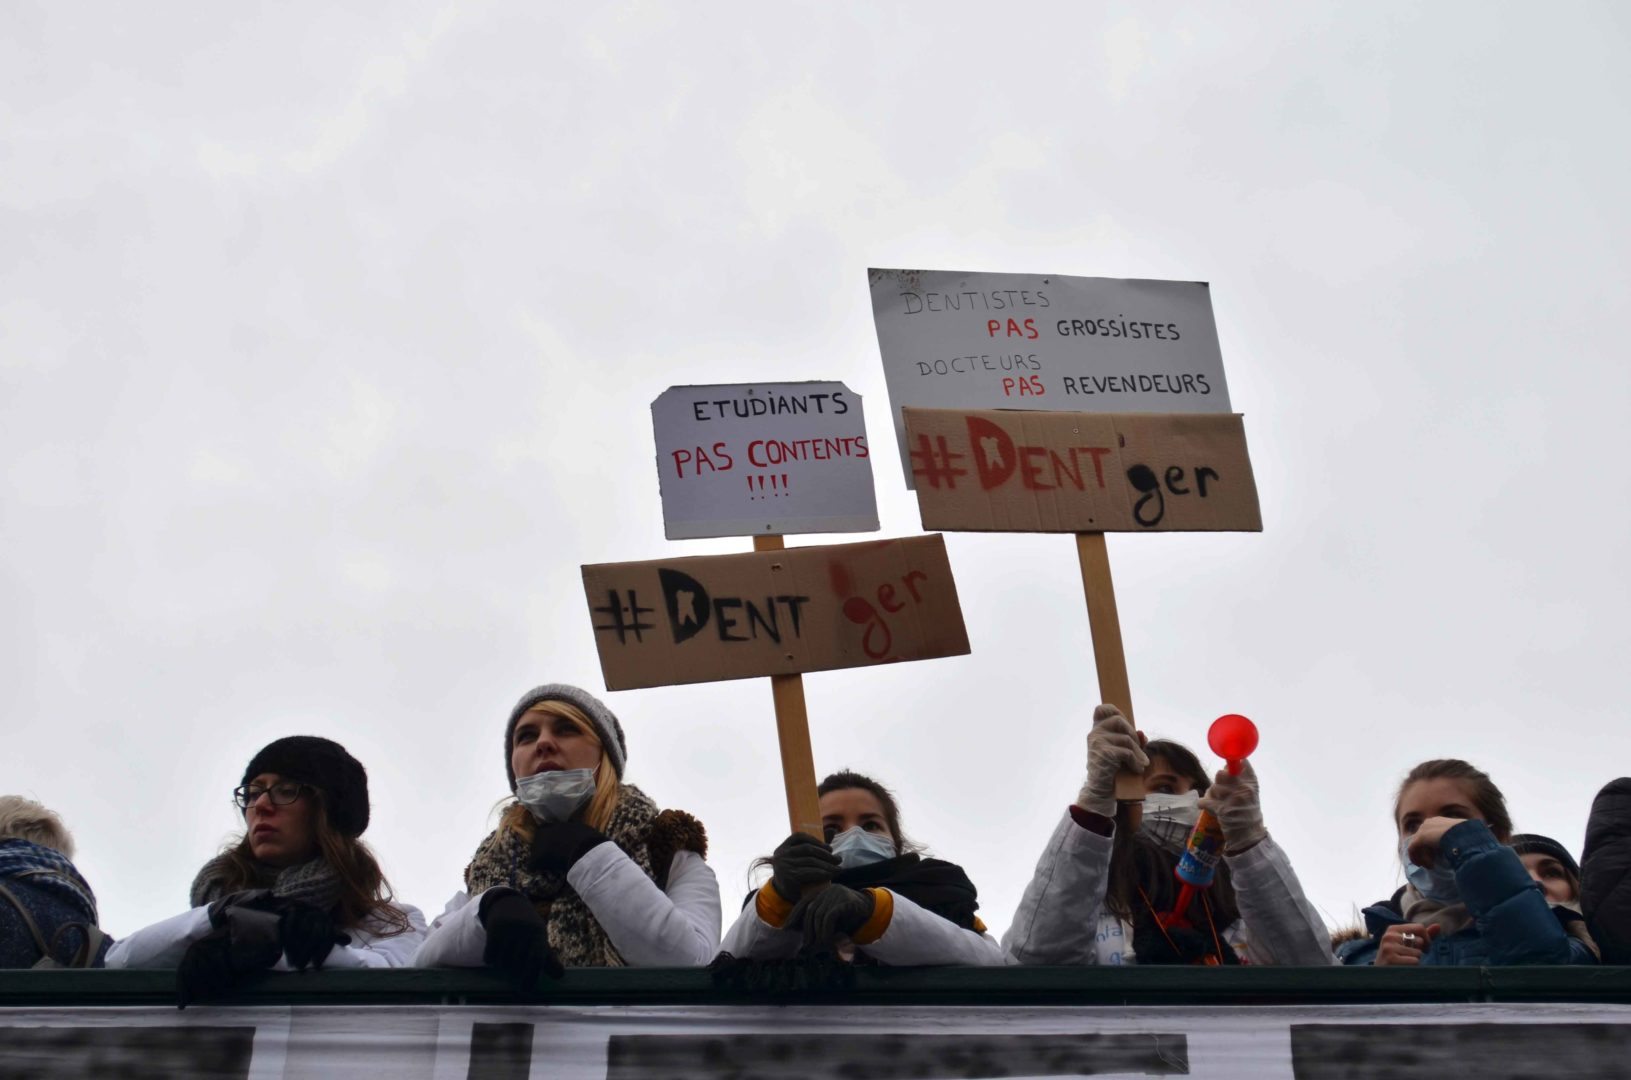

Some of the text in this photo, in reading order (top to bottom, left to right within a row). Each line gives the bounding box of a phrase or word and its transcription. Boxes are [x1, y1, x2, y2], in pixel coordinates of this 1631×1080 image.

[900, 289, 1050, 315] DENTISTES
[987, 318, 1039, 340] PAS
[916, 353, 1042, 376] DOCTEURS
[1002, 374, 1211, 396] PAS REVENDEURS
[671, 436, 869, 478] PAS CONTENTS
[746, 474, 789, 501] !!!!
